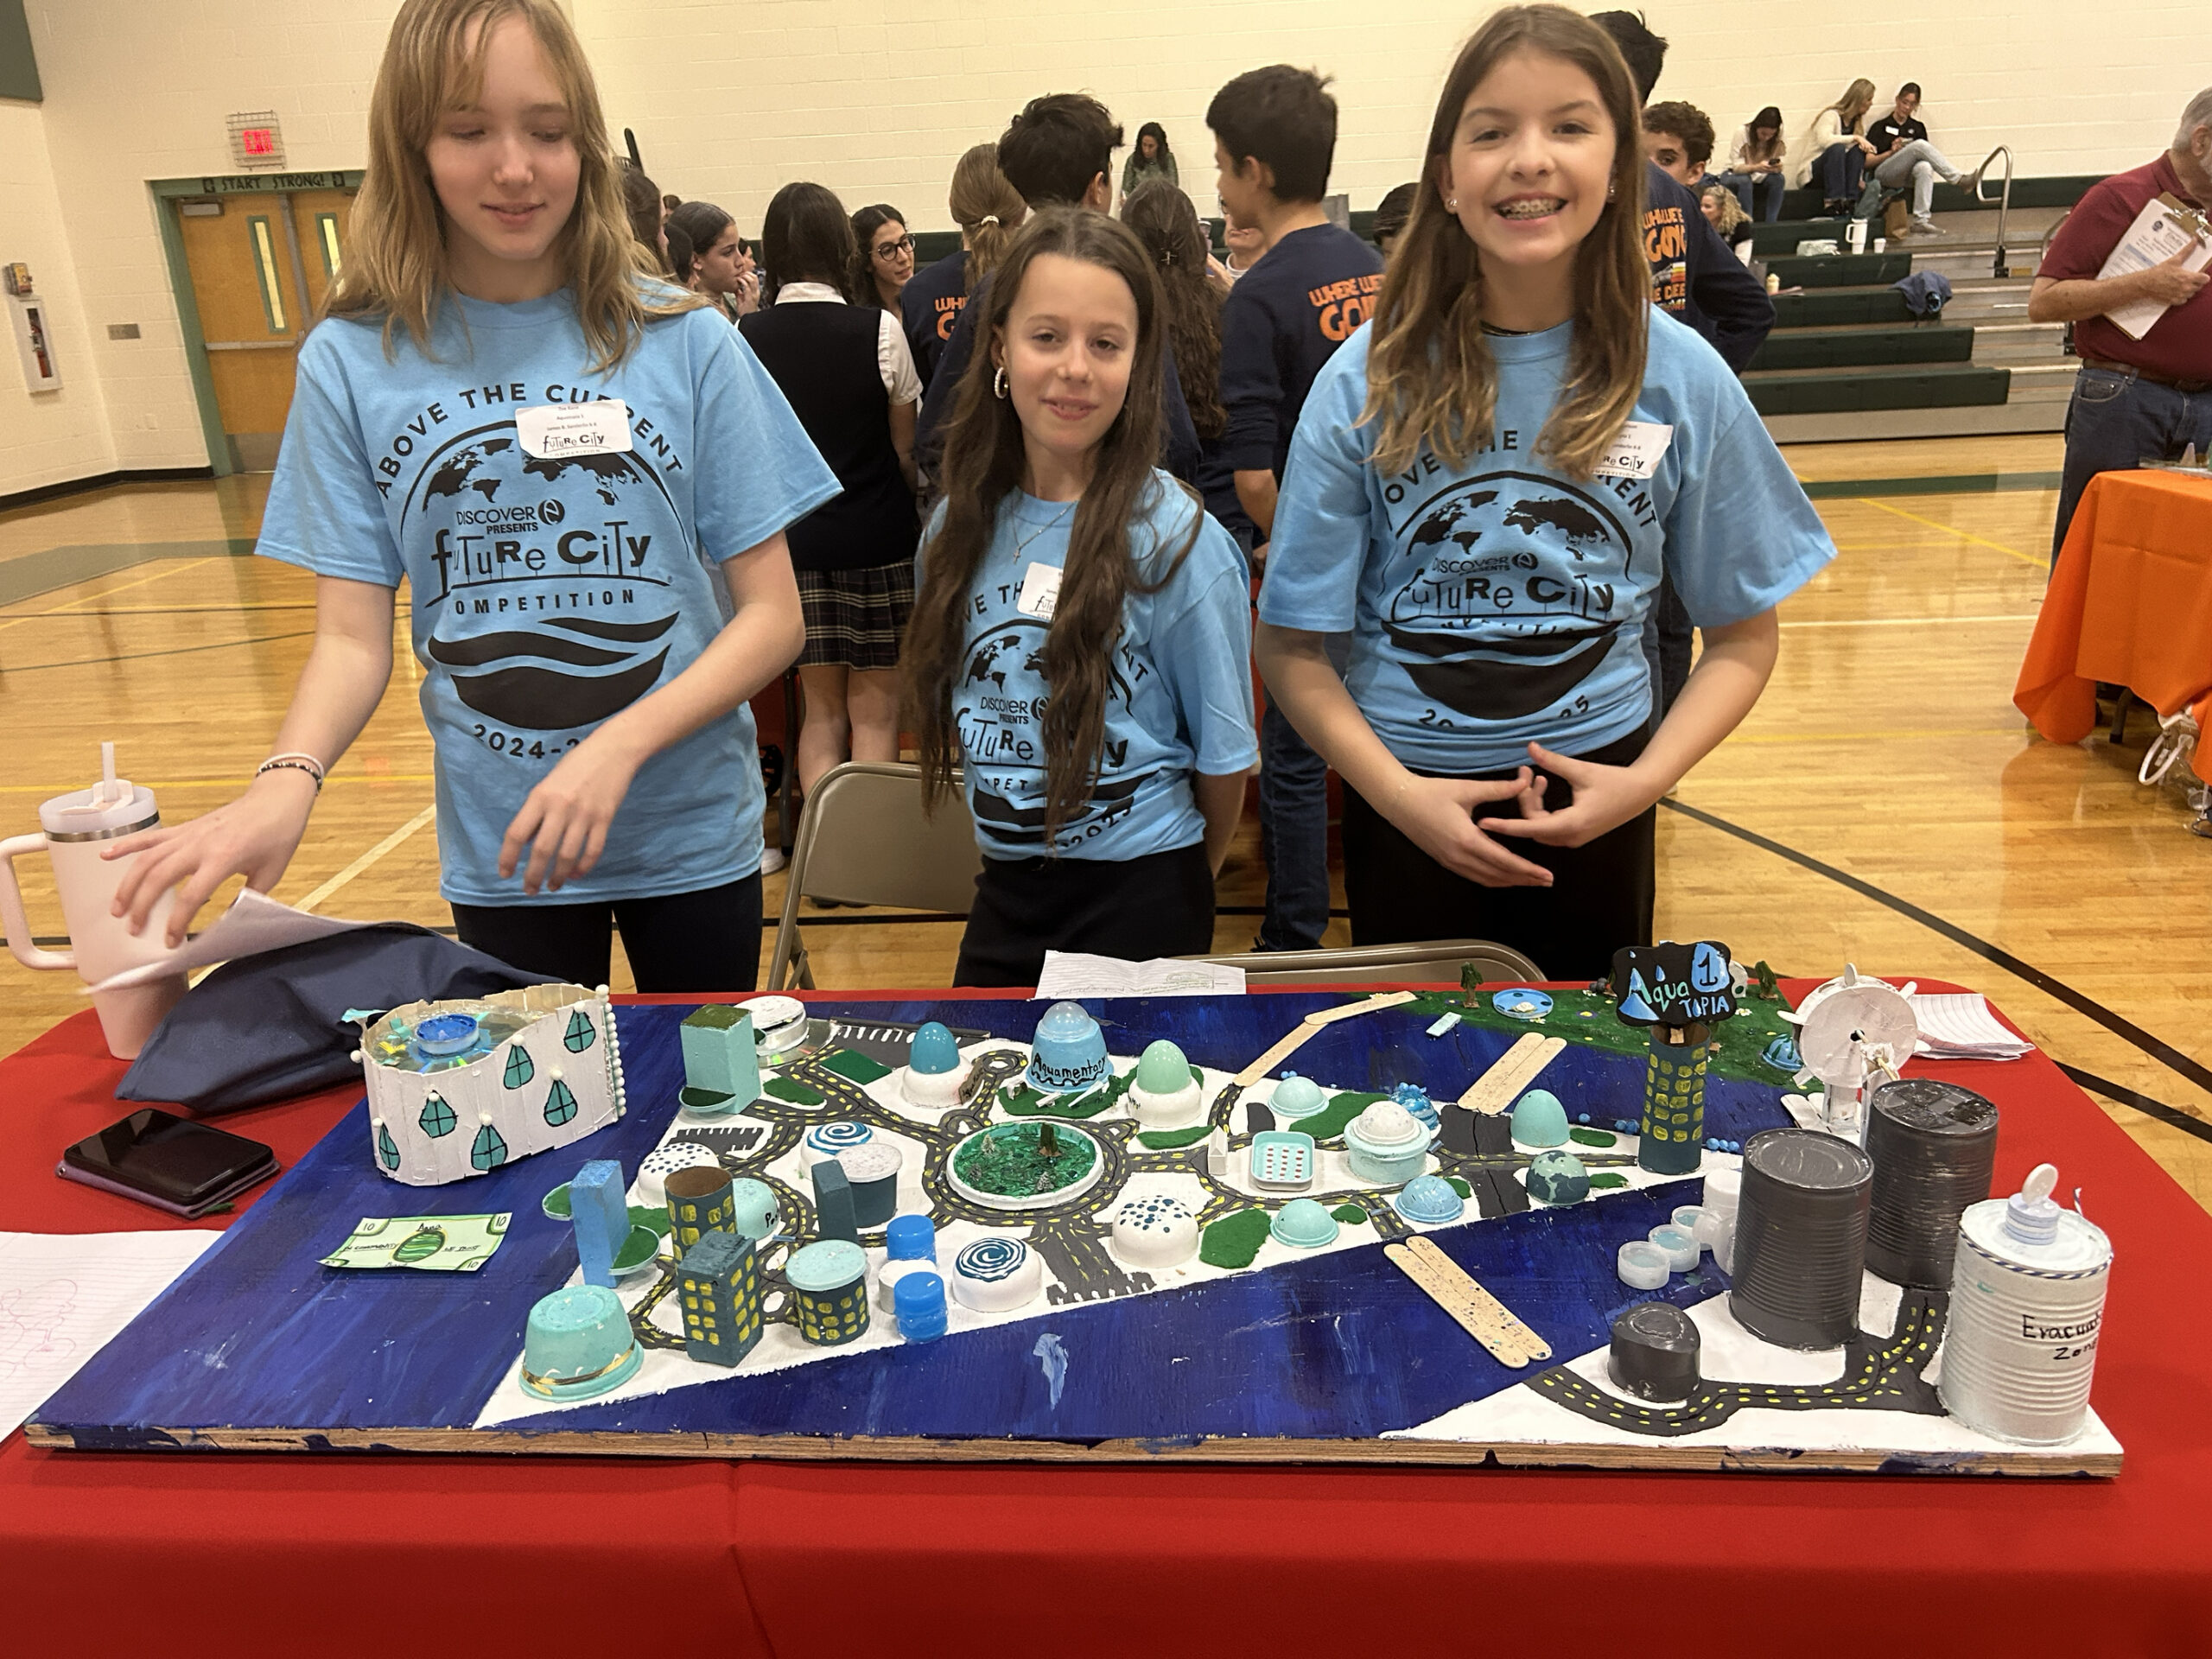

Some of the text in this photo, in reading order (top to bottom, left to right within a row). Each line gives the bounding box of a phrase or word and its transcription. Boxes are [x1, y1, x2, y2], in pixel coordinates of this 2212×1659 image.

[221, 173, 325, 191] START STRONG!
[376, 383, 683, 500] ABOVE THE CUENT
[1384, 452, 1440, 505] OVE
[486, 522, 538, 535] PRESENTS
[454, 589, 634, 614] OMPETITION
[997, 580, 1025, 604] TH
[1626, 951, 1719, 1013] Aqua 1
[1679, 995, 1729, 1018] TOPIA
[363, 1222, 375, 1231] 10
[496, 1216, 507, 1227] 10
